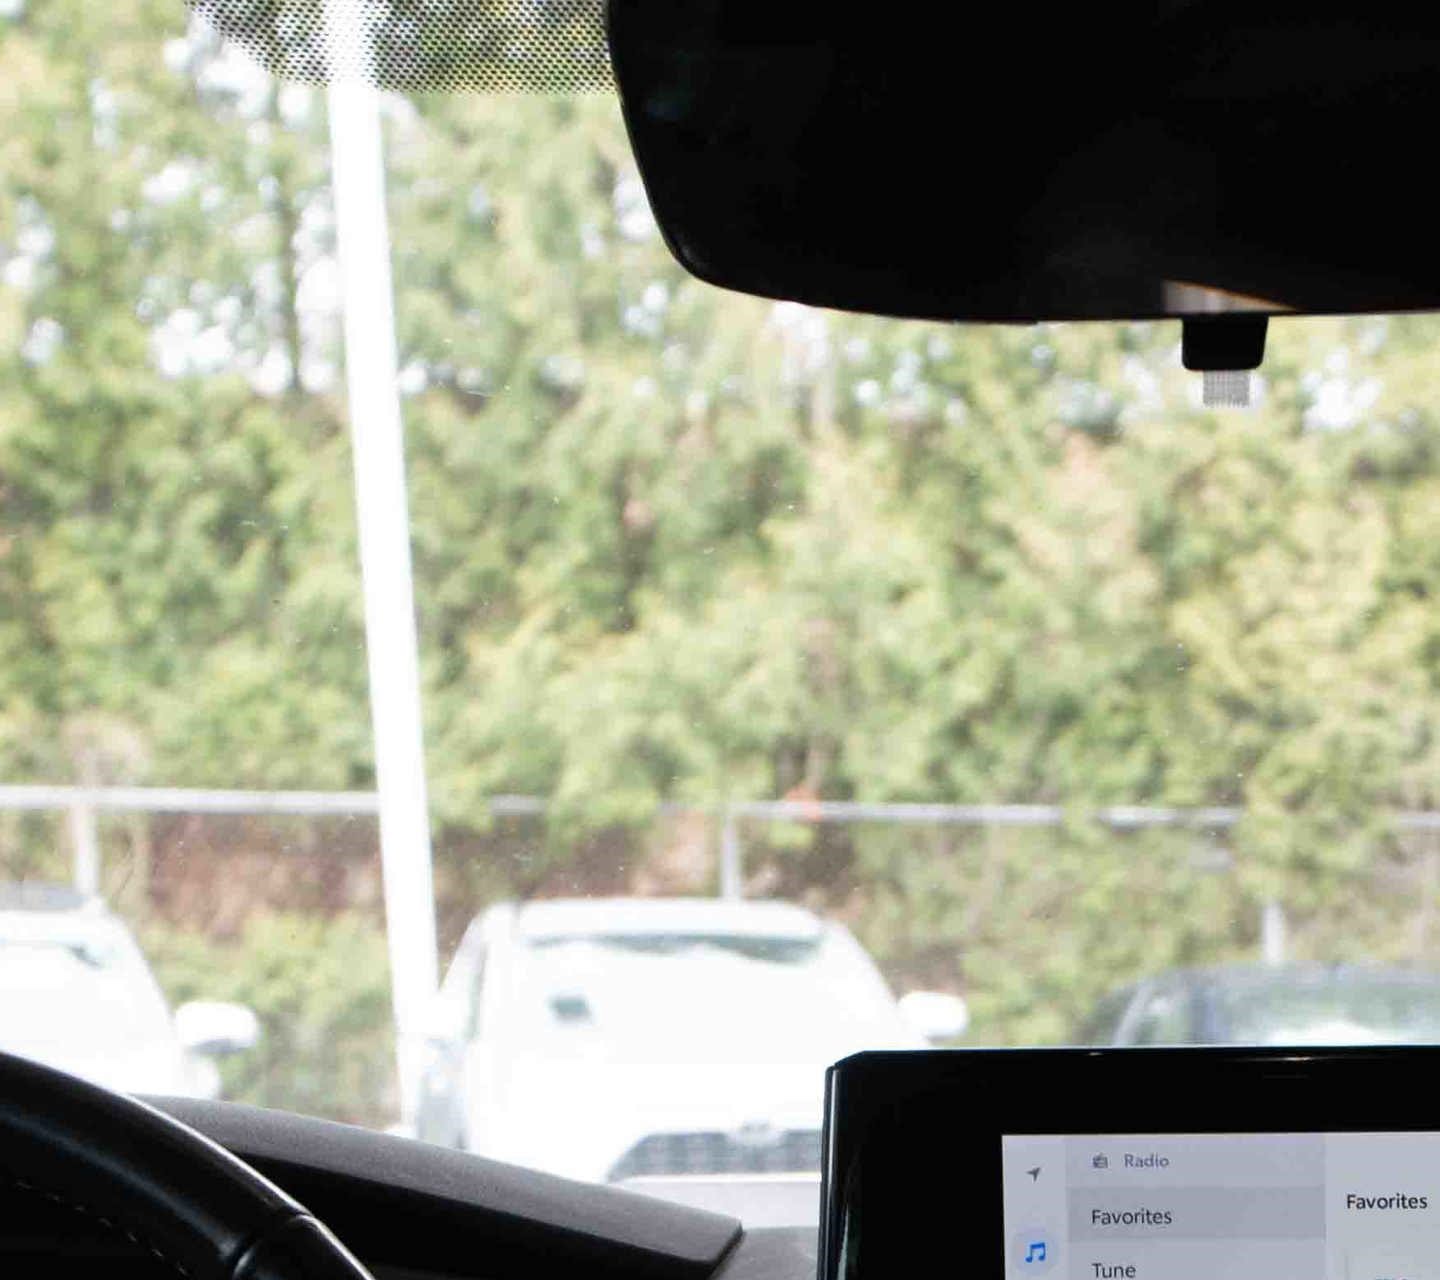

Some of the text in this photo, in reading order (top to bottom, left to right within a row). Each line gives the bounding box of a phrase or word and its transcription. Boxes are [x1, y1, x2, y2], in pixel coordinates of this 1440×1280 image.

[1124, 1153, 1170, 1168] Radio
[1346, 1194, 1428, 1210] Favorites
[1091, 1209, 1173, 1225] Favorites
[1092, 1262, 1137, 1279] Tune
